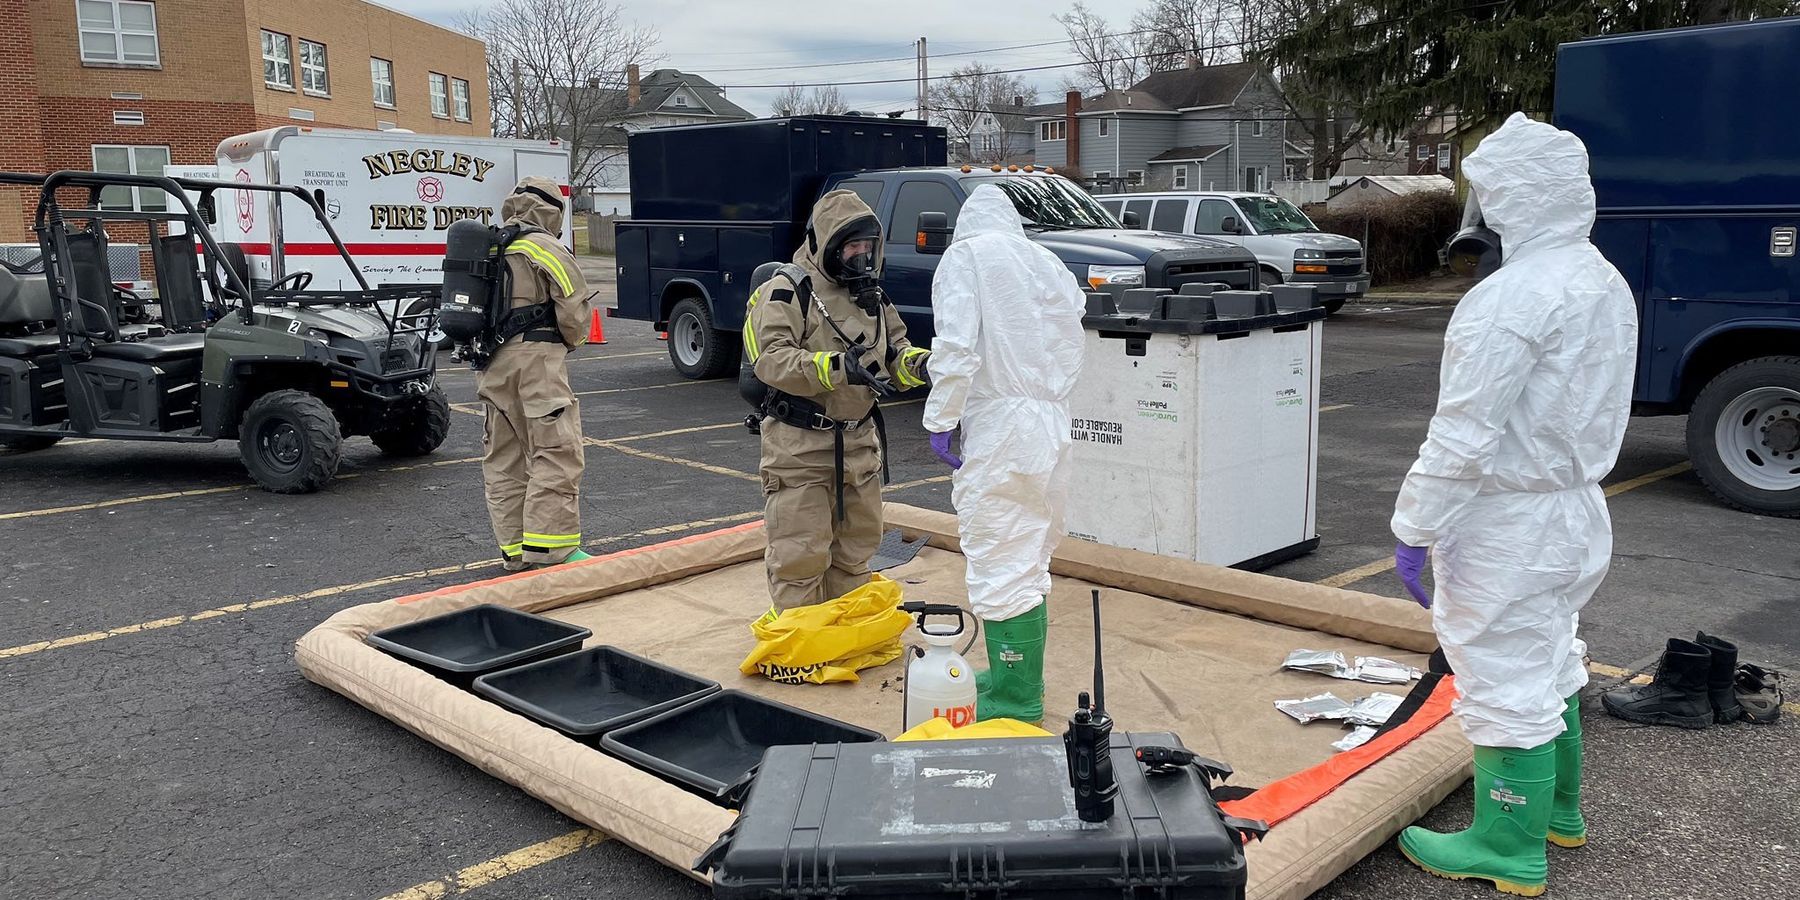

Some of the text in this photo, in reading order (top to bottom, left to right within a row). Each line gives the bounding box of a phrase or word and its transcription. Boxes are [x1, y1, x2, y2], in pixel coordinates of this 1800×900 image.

[362, 149, 495, 182] NEGLEY
[370, 204, 428, 230] FIRE
[362, 265, 394, 274] Serving
[398, 265, 411, 273] The
[290, 321, 299, 332] 2
[1085, 419, 1122, 433] REUSABLE
[1091, 432, 1122, 445] HANDLE
[933, 702, 976, 729] HDX
